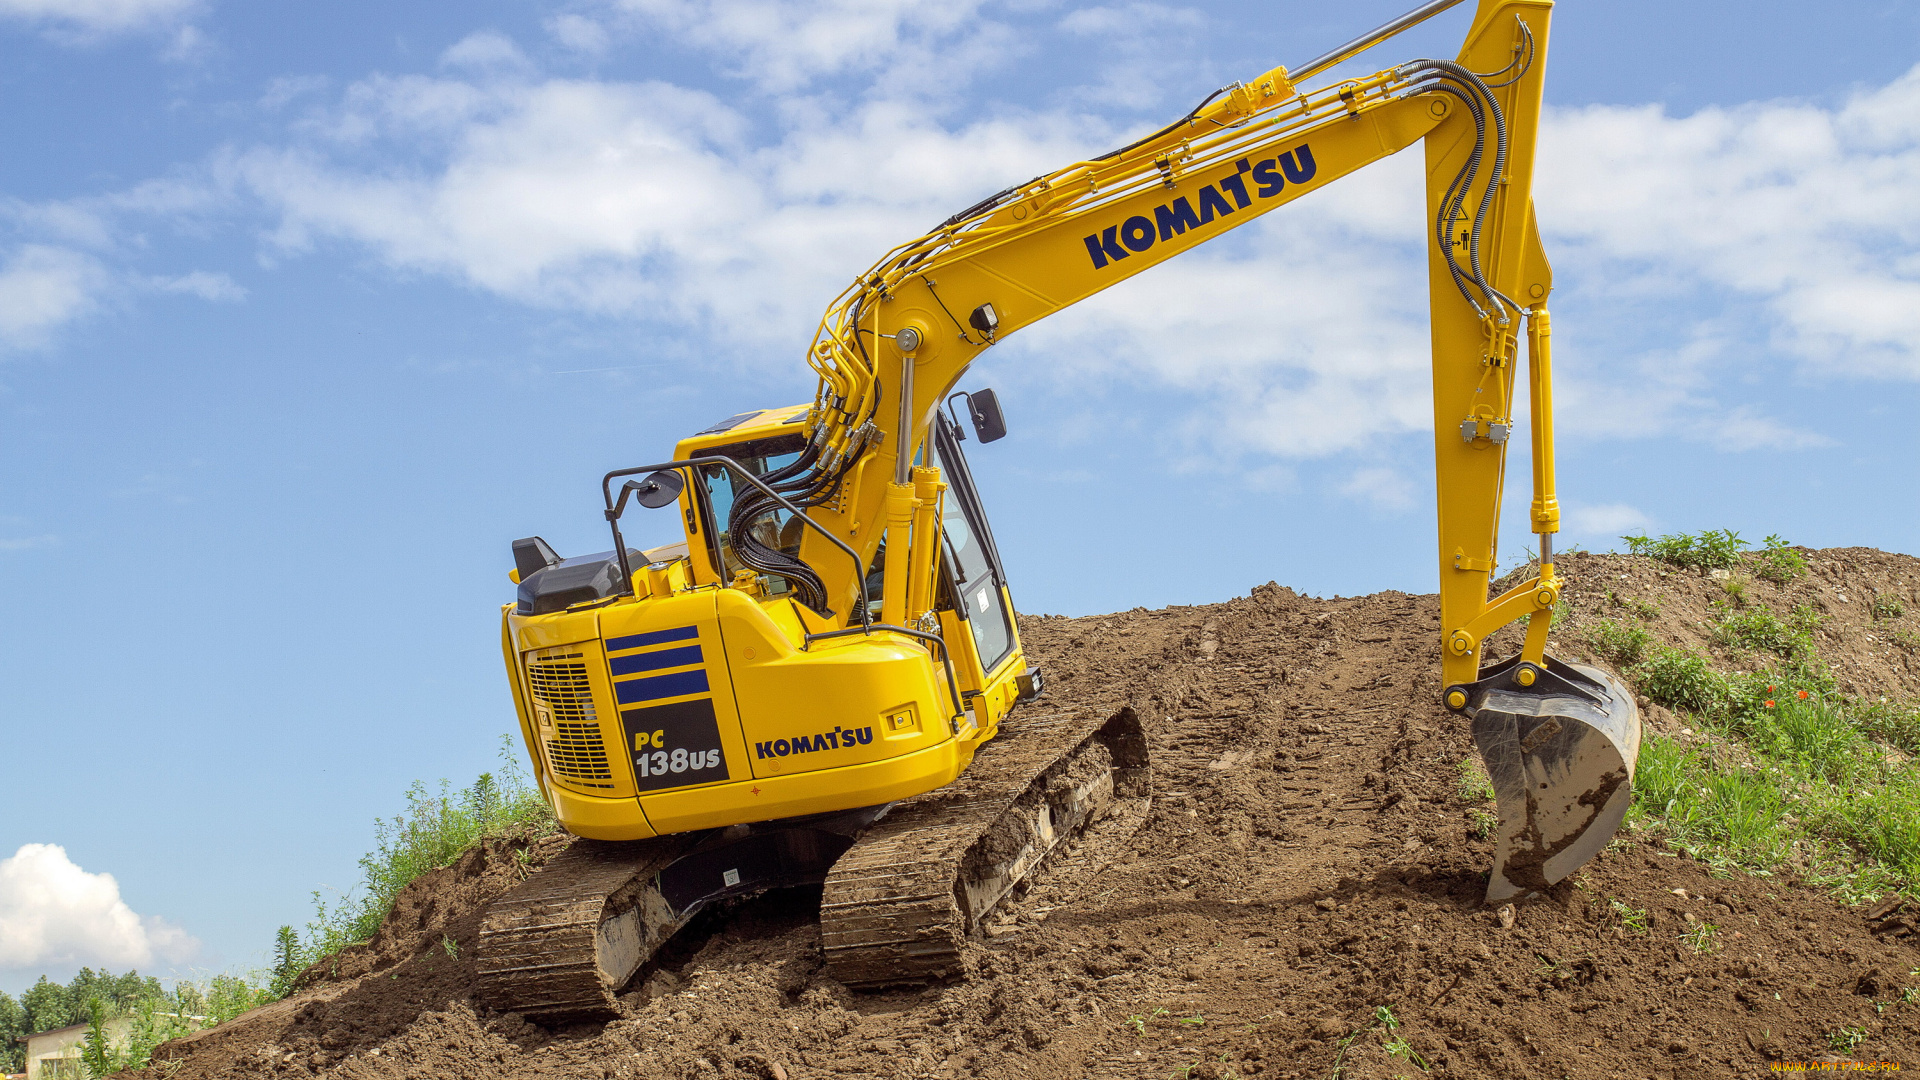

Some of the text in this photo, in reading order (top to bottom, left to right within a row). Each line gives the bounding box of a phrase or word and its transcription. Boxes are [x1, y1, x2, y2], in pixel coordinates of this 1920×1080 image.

[1083, 143, 1317, 270] KOMATSU
[634, 730, 664, 751] PC
[755, 726, 874, 760] KOMATSU
